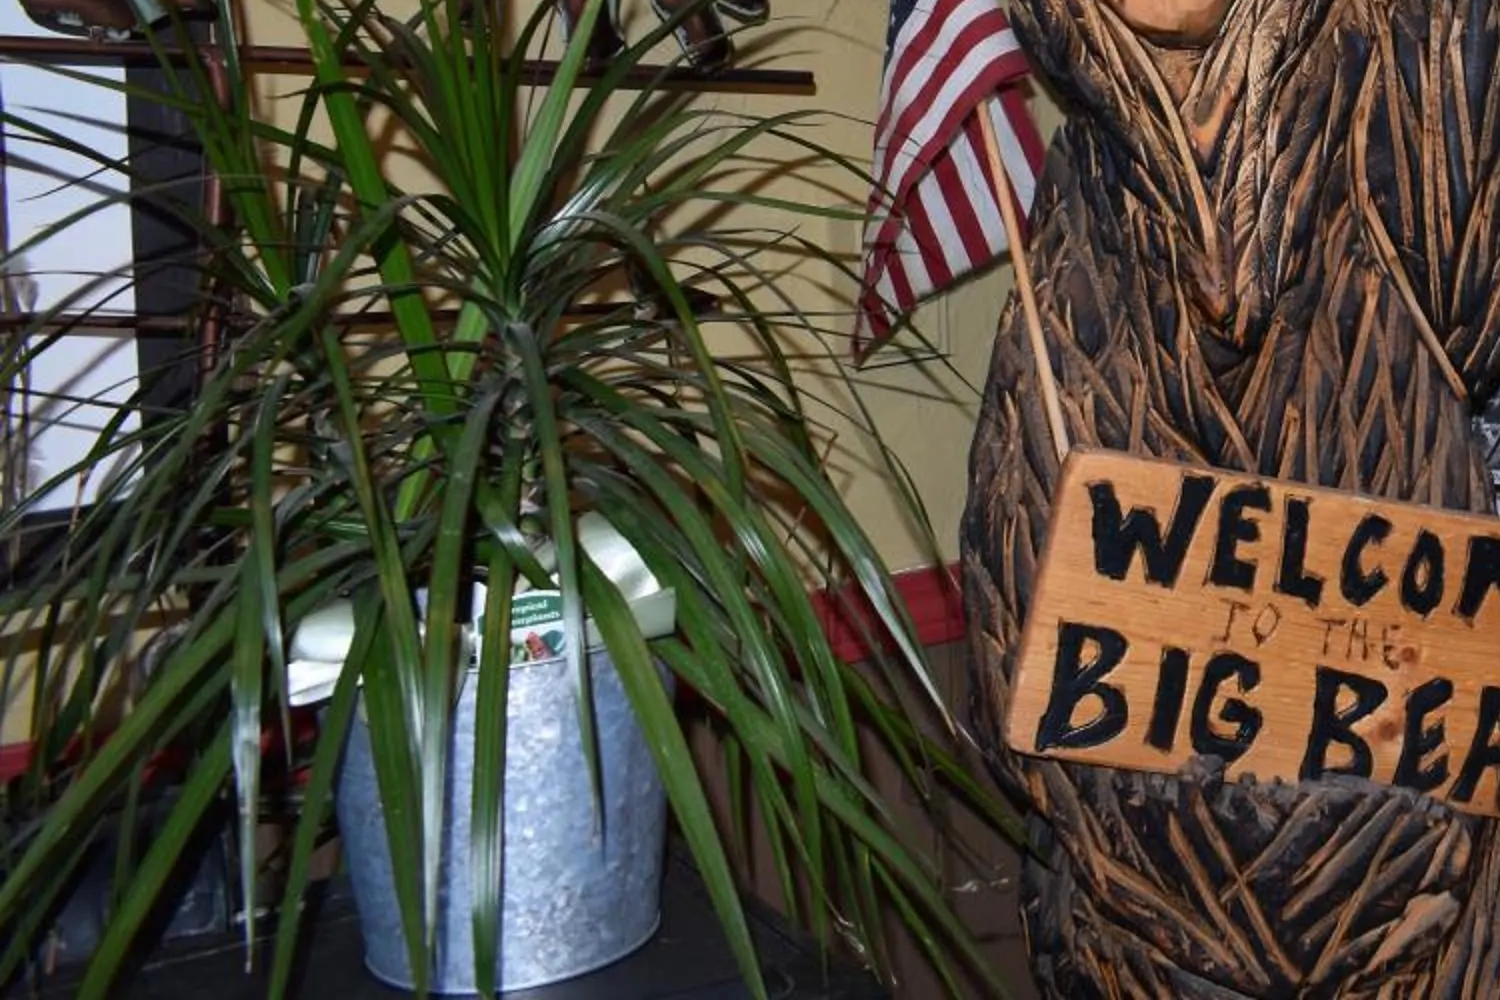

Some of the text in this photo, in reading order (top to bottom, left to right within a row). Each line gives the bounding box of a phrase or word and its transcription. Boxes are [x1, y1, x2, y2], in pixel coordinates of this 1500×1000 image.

[1212, 600, 1401, 670] TO THE
[1036, 618, 1263, 763] BIG
